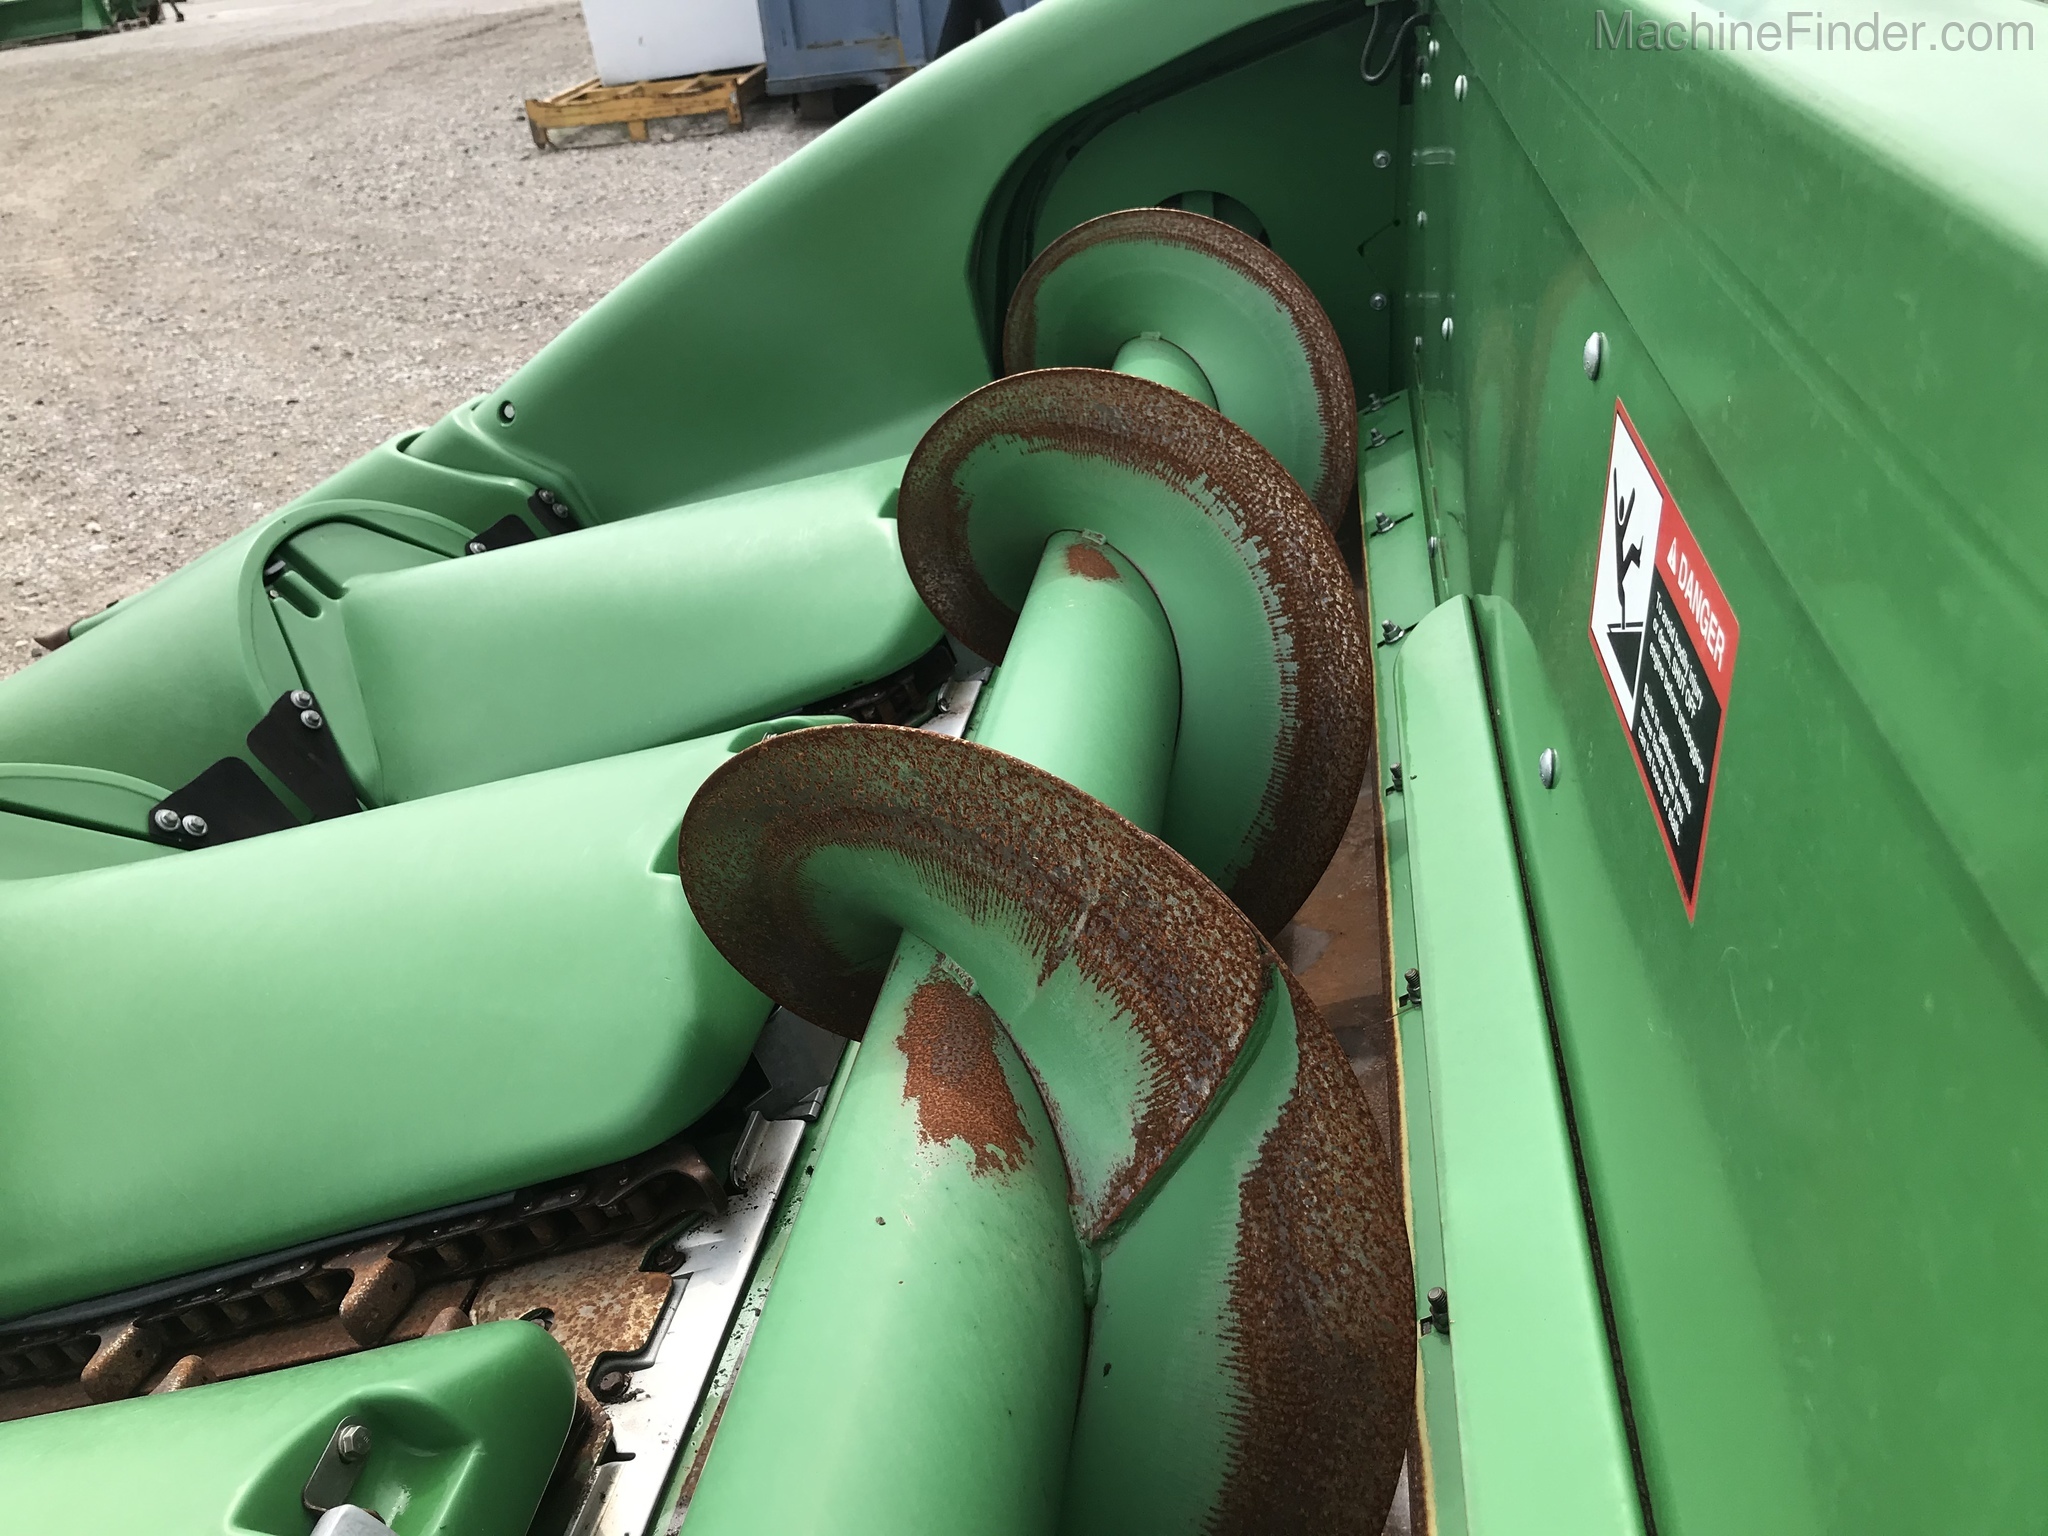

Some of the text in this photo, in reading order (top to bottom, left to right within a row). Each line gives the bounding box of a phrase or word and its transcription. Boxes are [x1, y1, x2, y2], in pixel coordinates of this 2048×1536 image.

[1652, 618, 1696, 719] or death, SHUT OFF
[1656, 591, 1703, 710] To avoid bodily injury
[1678, 552, 1725, 672] DANGER
[1640, 706, 1684, 825] move faster than you
[1643, 682, 1692, 814] Rolls in gathering units
[1649, 641, 1704, 783] engine before unclogging.
[1638, 726, 1680, 846] can let loose of stalk.
